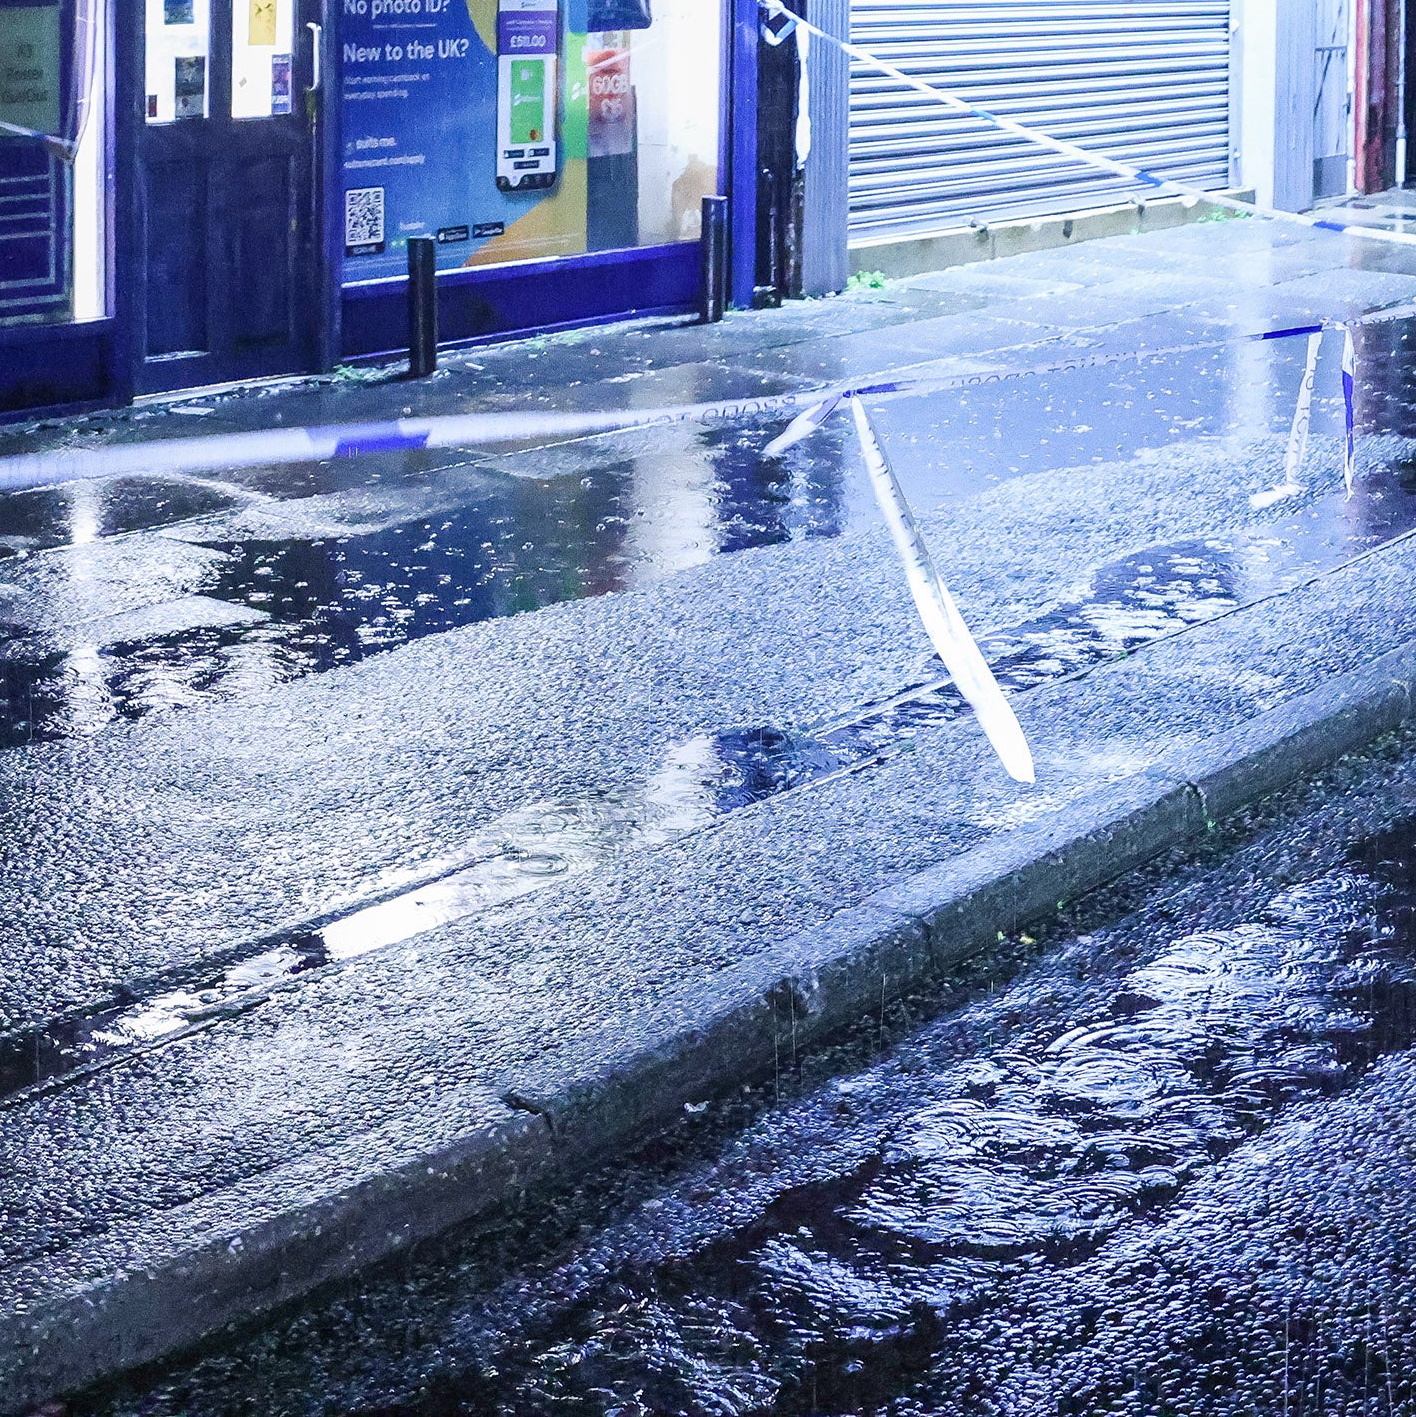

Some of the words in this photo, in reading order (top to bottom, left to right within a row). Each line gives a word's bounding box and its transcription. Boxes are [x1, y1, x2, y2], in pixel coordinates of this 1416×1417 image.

[343, 42, 382, 62] New
[385, 43, 403, 61] to
[406, 40, 435, 60] the
[438, 38, 470, 59] UK?
